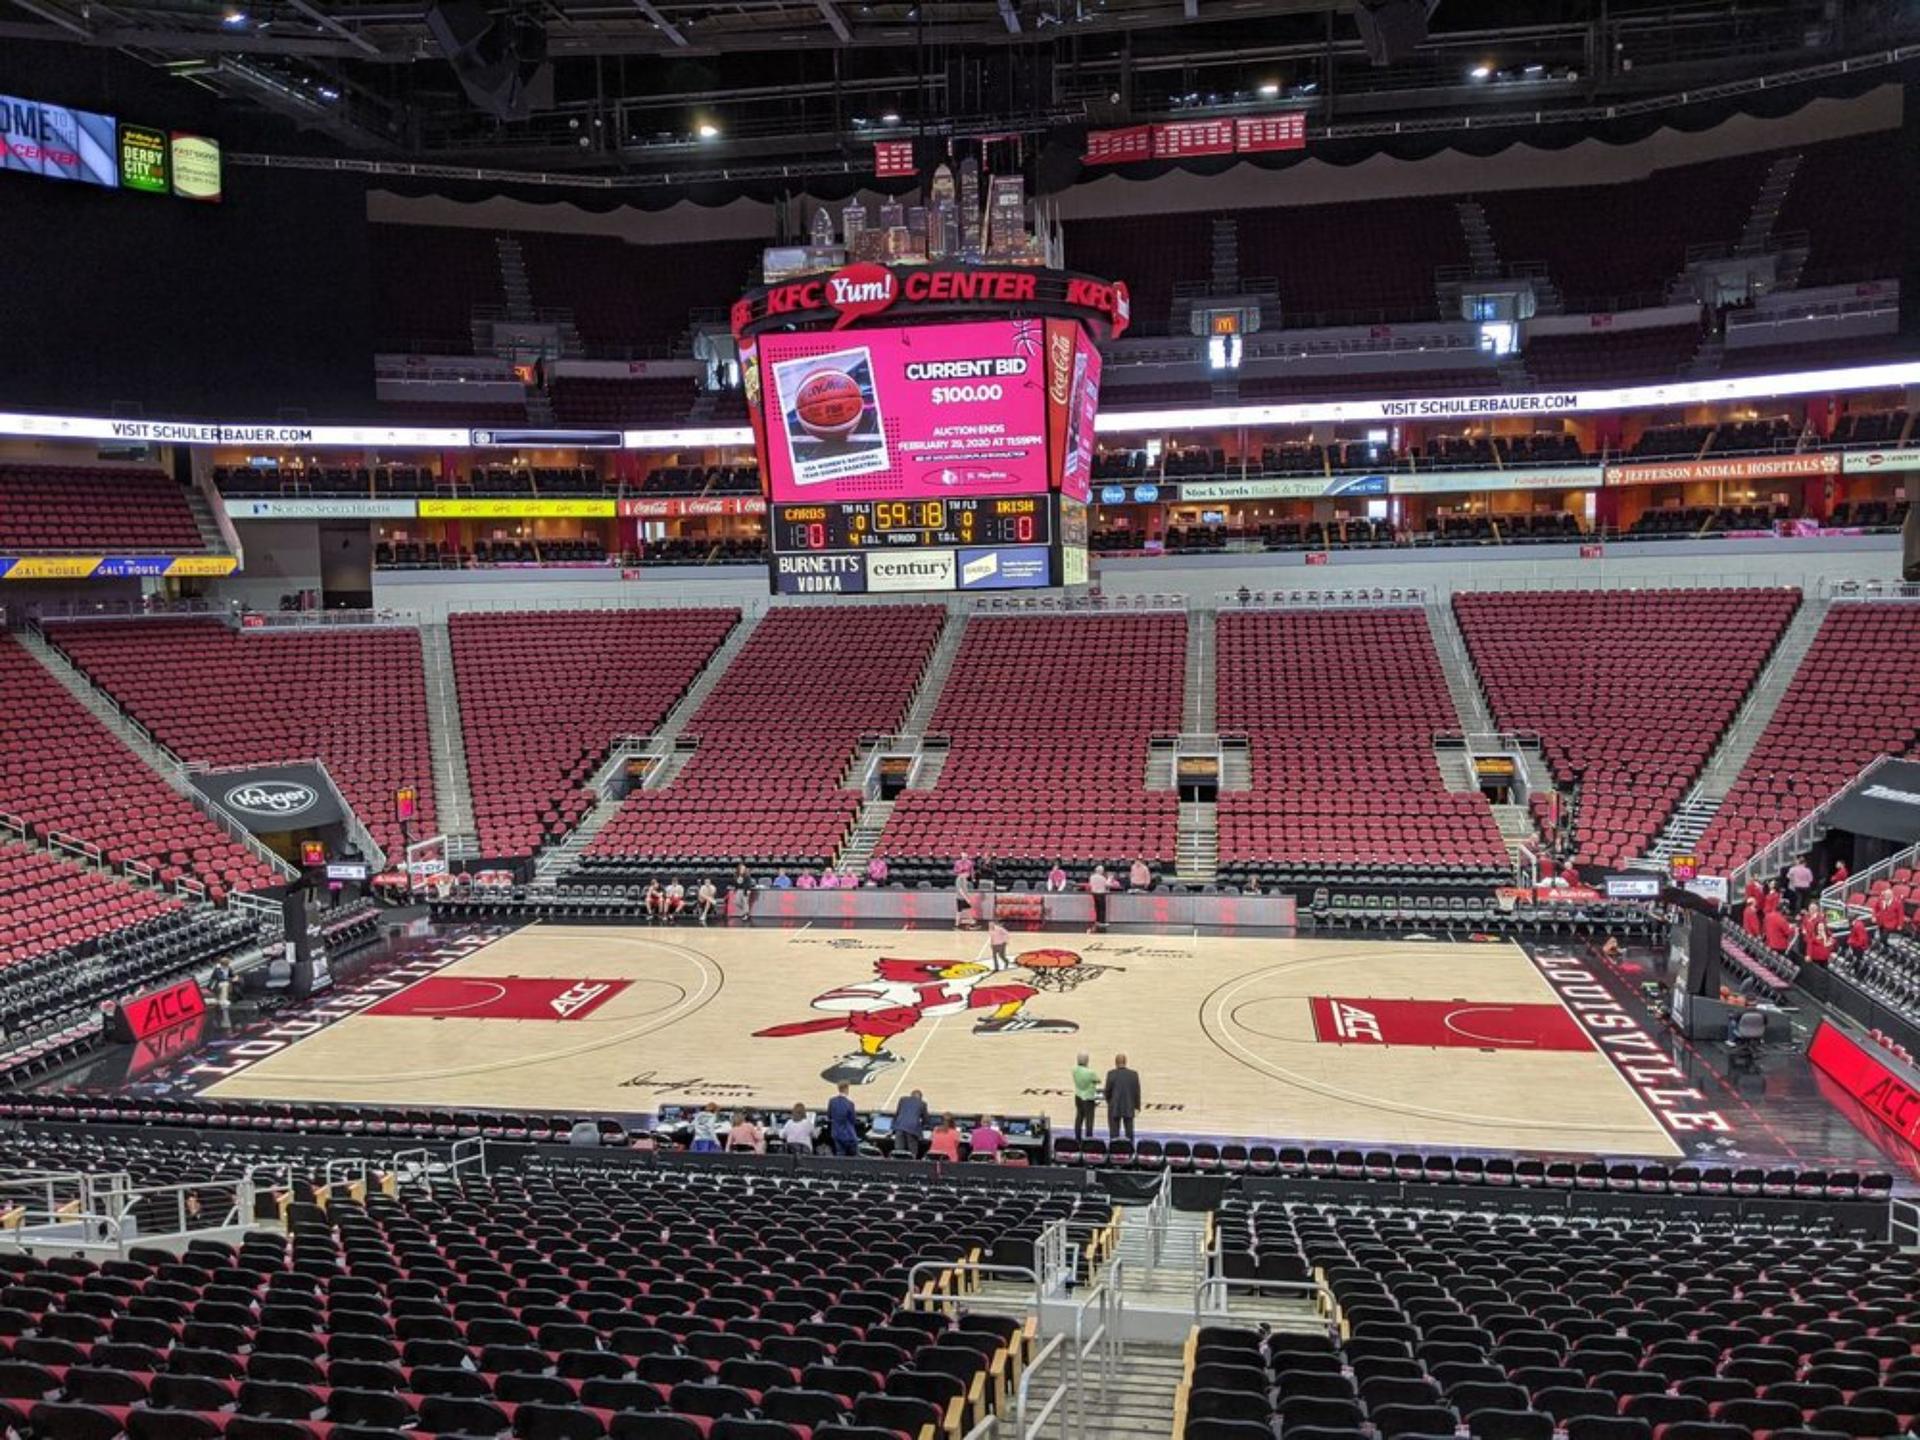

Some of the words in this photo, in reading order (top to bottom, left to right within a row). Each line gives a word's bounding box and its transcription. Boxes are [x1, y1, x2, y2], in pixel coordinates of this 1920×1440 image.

[124, 146, 163, 165] DERBY
[124, 160, 150, 175] CITY
[767, 281, 821, 315] KFC
[830, 265, 892, 304] Yum!
[905, 272, 1037, 300] CENTER
[906, 360, 993, 379] CURRENT
[996, 358, 1027, 374] BID
[932, 384, 1003, 405] $100.00
[1381, 402, 1416, 415] VISIT
[1420, 395, 1578, 414] SCHULERBAUER.COM
[112, 423, 149, 437] VISIT
[153, 424, 313, 441] SCHULERBAUER.COM
[1623, 468, 1691, 483] JEFFERSON
[1693, 465, 1744, 478] ANIMAL
[1747, 459, 1820, 474] HOSPITALS
[1184, 487, 1217, 498] Stock
[1219, 486, 1250, 497] Yards
[784, 508, 826, 521] CARDS
[855, 515, 865, 530] 0
[876, 502, 942, 528] 59:18
[963, 512, 972, 526] 0
[809, 523, 825, 548] 0
[849, 532, 859, 545] 4
[961, 530, 972, 542] 4
[1019, 516, 1032, 541] 0
[98, 566, 125, 575] GALT
[128, 565, 161, 575] HOUSE
[779, 555, 861, 573] BURNETT'S
[873, 559, 950, 580] century
[798, 576, 841, 592] VODKA
[236, 788, 306, 810] Kroger
[550, 981, 605, 1015] ACC
[144, 986, 195, 1031] ACC
[1339, 1003, 1383, 1042] ACC
[1535, 956, 1735, 1131] LOUISVILLE
[1021, 1088, 1073, 1096] KFC
